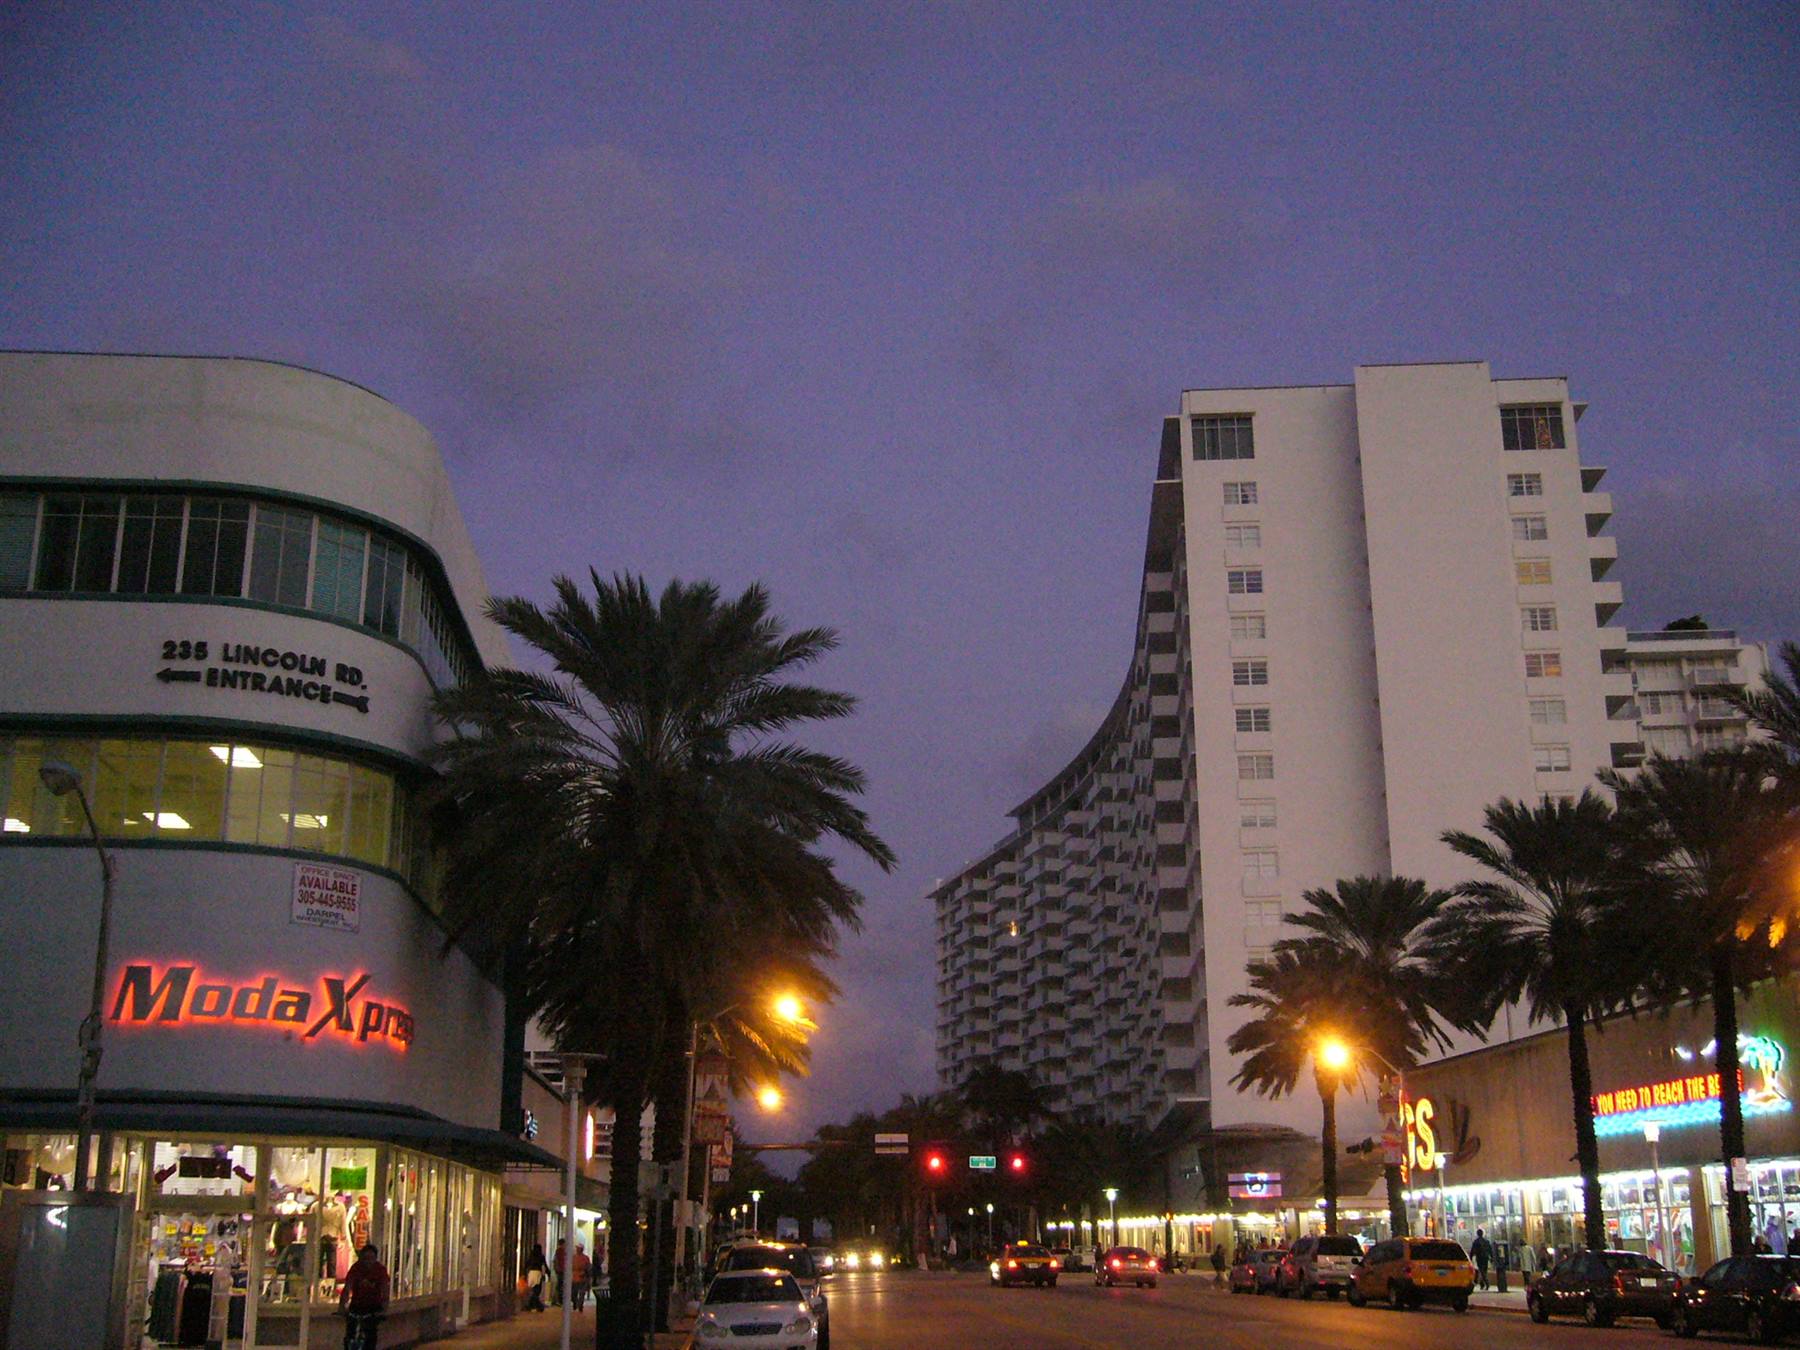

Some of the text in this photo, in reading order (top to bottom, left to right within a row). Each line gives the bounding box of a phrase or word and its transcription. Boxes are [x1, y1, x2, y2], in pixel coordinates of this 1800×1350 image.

[162, 640, 367, 690] 235 LINCOLN RD.
[206, 667, 332, 704] ENTRANCE
[299, 875, 357, 896] AVAILABLE
[1597, 1094, 1614, 1115] YOU
[1615, 1089, 1637, 1111] NEED
[1639, 1086, 1651, 1108] TO
[1653, 1080, 1684, 1105] REACH
[1686, 1077, 1706, 1100] THE
[355, 1195, 369, 1249] SALE
